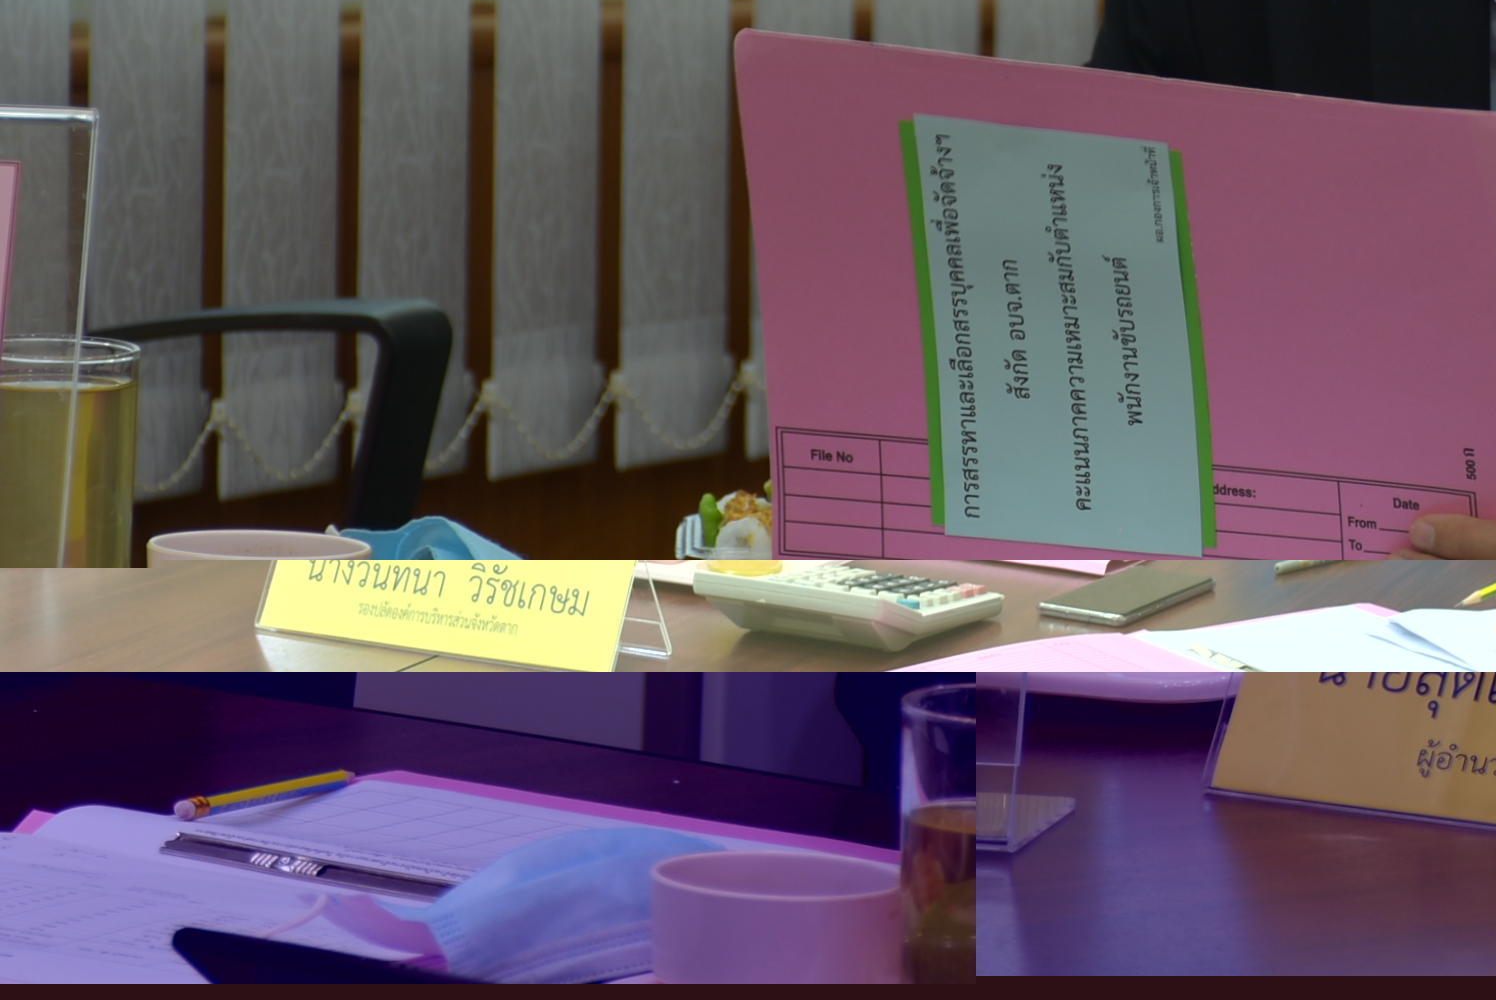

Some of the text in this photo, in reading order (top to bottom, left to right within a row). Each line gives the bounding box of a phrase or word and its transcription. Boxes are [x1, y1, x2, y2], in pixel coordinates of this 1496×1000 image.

[998, 259, 1030, 400] สังกัด อบจ.ตาก
[1041, 163, 1092, 512] คะแนนภาคความเหมาะสมกับตำแหน่ง
[1103, 256, 1143, 427] พนักงานขับรถยนต์
[810, 448, 854, 463] File No
[1464, 459, 1477, 481] 500
[1213, 484, 1257, 499] ddress:
[1392, 497, 1420, 511] Date
[1347, 516, 1377, 530] From
[1348, 539, 1363, 551] To
[308, 560, 591, 617] นางวนทนา วิรัชเกษม
